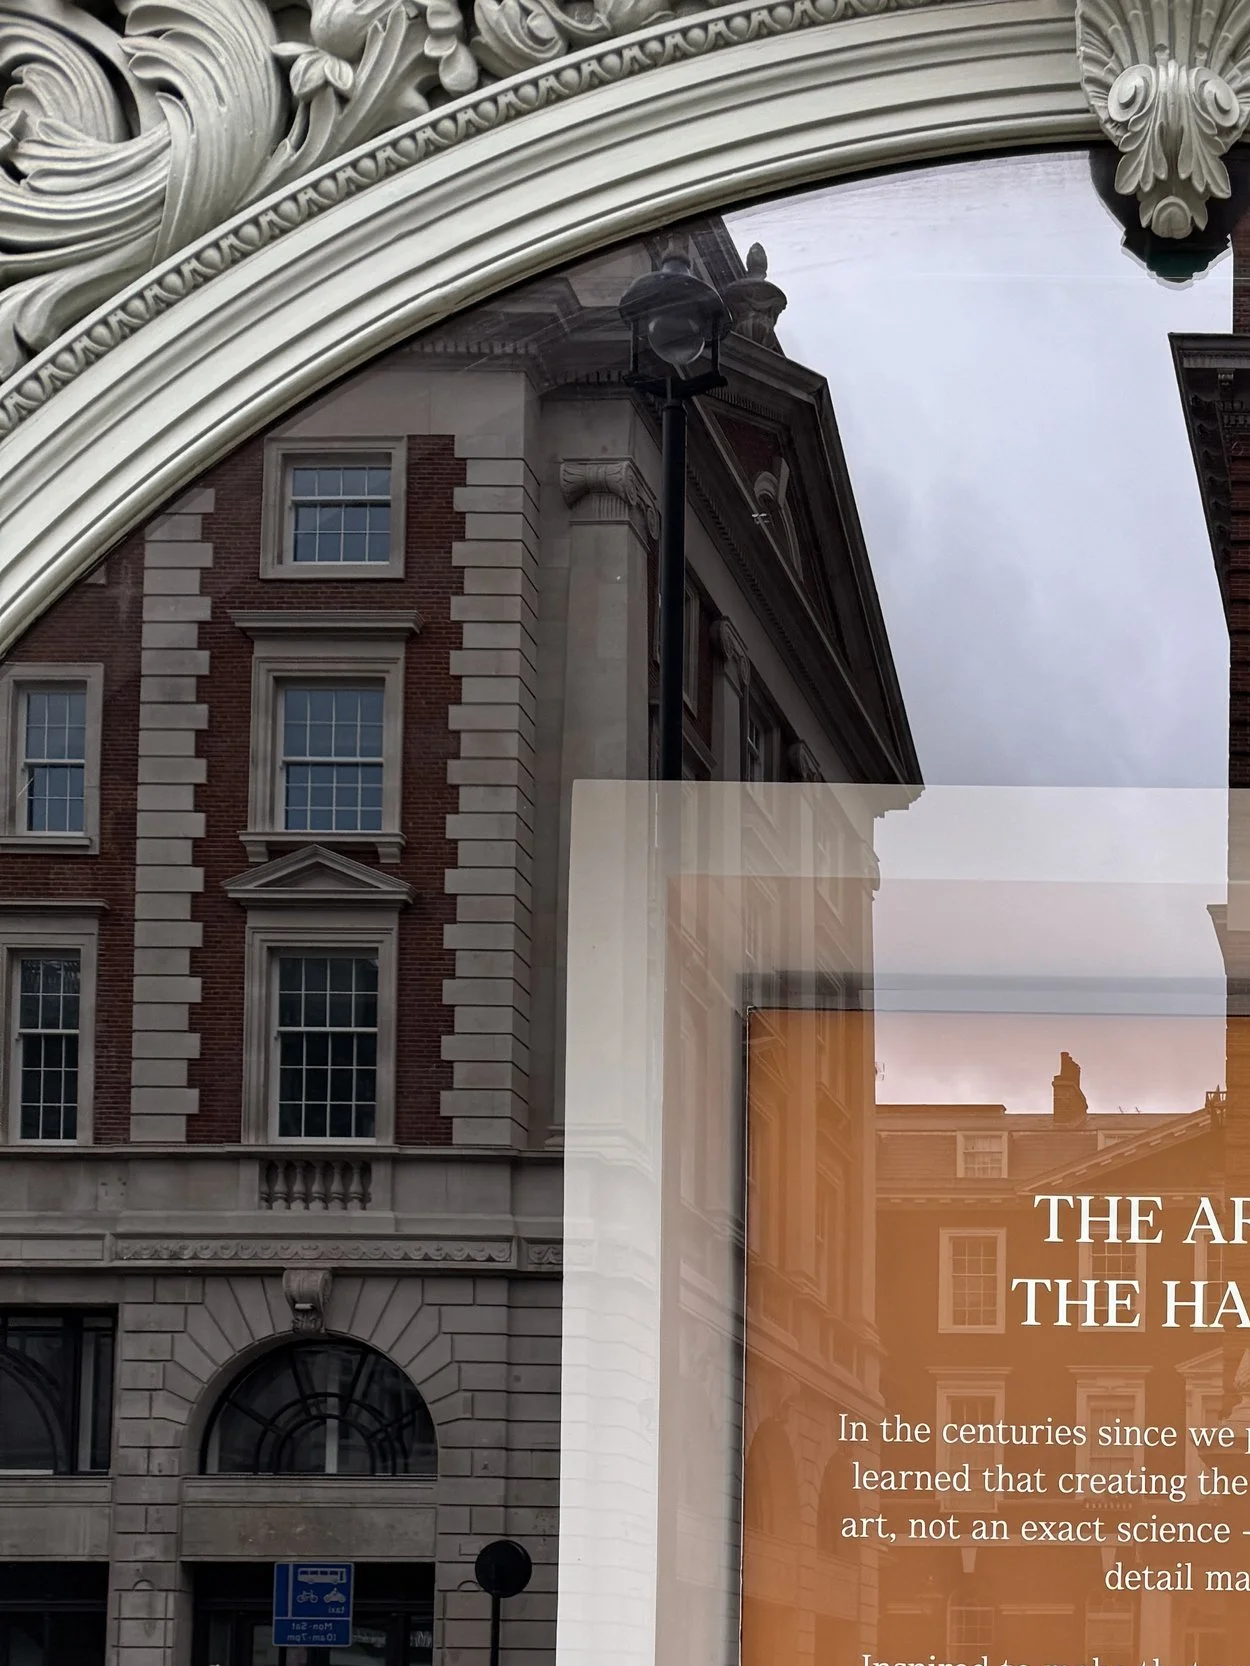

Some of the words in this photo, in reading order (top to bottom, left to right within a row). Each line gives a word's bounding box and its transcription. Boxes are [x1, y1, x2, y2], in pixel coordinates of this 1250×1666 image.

[1033, 1194, 1163, 1244] THE
[1011, 1278, 1141, 1328] THE
[838, 1413, 869, 1442] In
[879, 1414, 931, 1443] the
[942, 1417, 1087, 1446] centuries
[1098, 1418, 1178, 1447] since
[1187, 1427, 1235, 1448] we
[852, 1461, 972, 1492] learned
[981, 1463, 1048, 1493] that
[1058, 1466, 1188, 1503] creating
[1197, 1466, 1249, 1496] the
[841, 1513, 896, 1543] art,
[907, 1514, 961, 1540] not
[971, 1519, 1011, 1540] an
[1021, 1517, 1107, 1543] exact
[1117, 1514, 1231, 1544] science
[1104, 1561, 1194, 1591] detail
